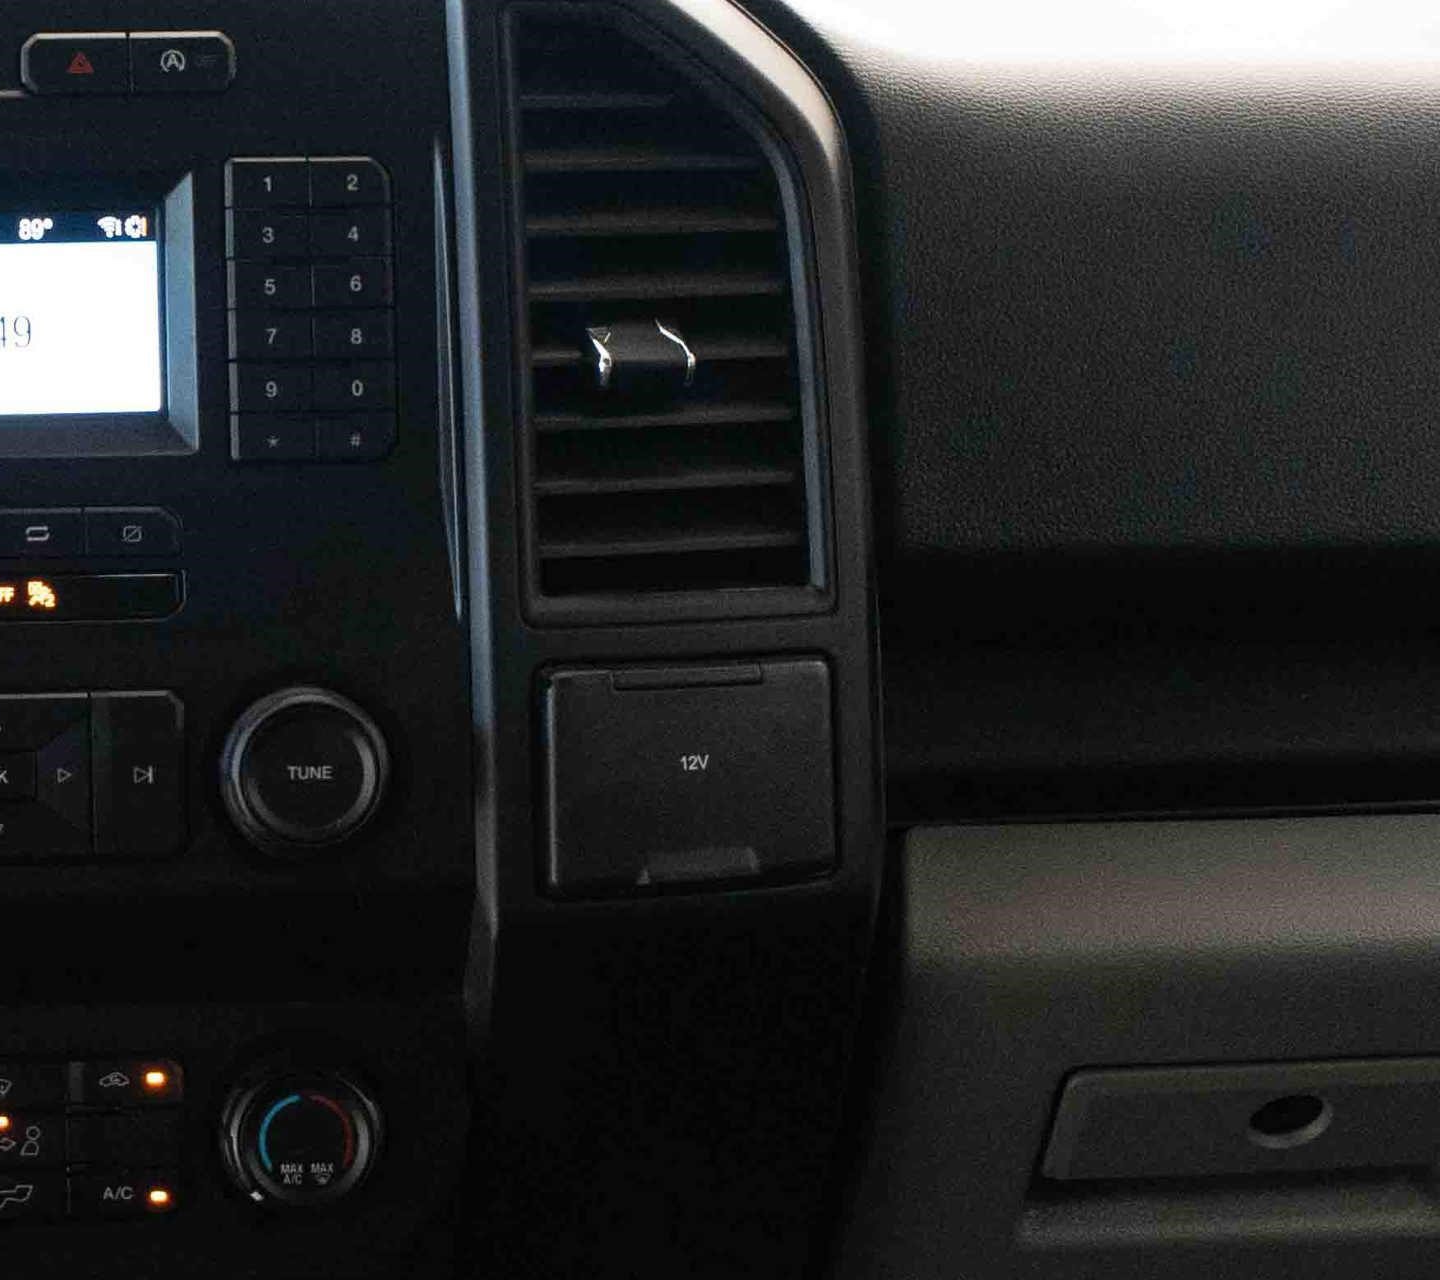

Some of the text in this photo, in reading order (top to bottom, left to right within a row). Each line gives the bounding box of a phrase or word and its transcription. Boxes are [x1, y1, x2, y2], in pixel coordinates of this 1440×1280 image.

[263, 176, 273, 192] 1
[347, 174, 359, 191] 2
[262, 227, 274, 244] 3
[347, 225, 359, 242] 4
[264, 278, 276, 295] 5
[350, 275, 362, 292] 6
[266, 328, 277, 344] 7
[350, 328, 362, 345] 8
[266, 381, 278, 398] 9
[352, 380, 364, 397] 0
[680, 754, 710, 772] 12V
[287, 765, 333, 781] TUNE
[280, 1162, 304, 1174] MAX
[310, 1162, 334, 1174] MAX
[102, 1184, 134, 1202] A/C
